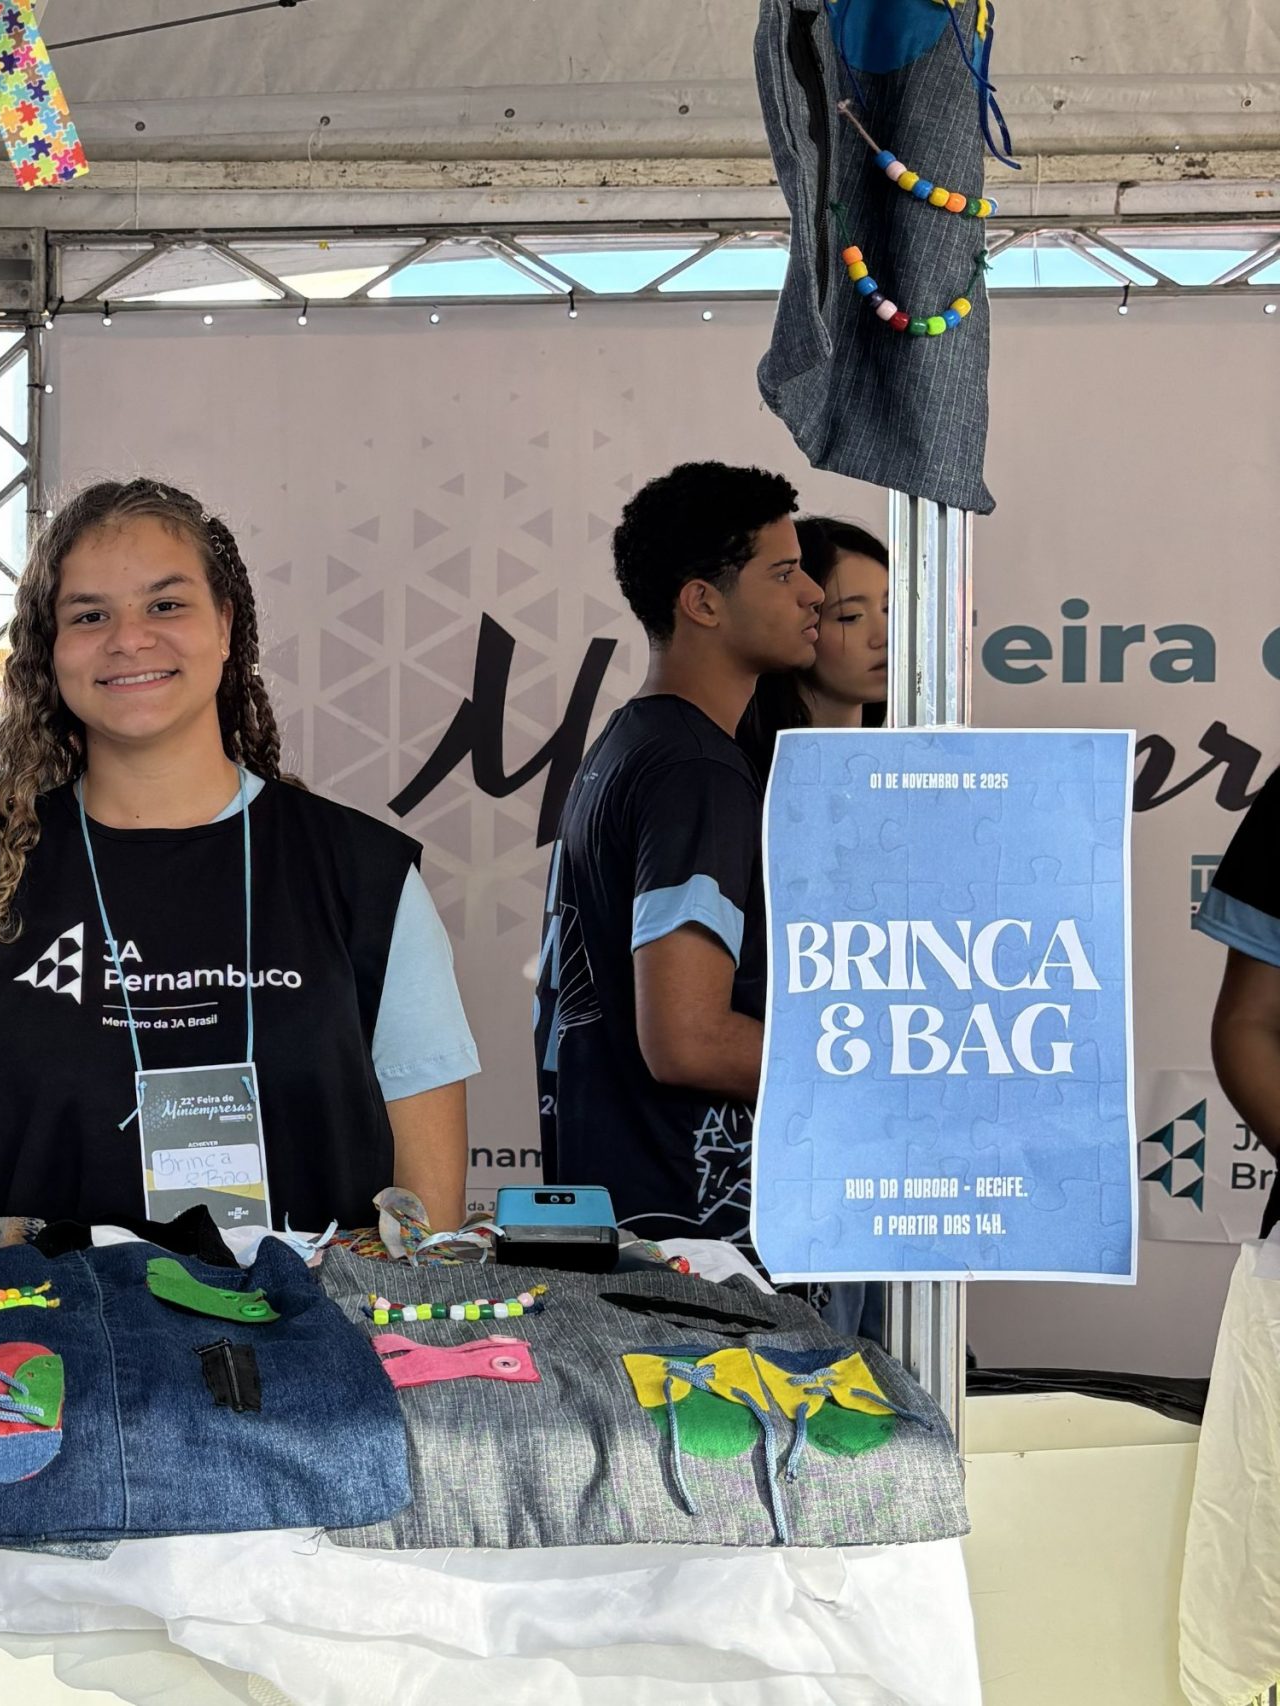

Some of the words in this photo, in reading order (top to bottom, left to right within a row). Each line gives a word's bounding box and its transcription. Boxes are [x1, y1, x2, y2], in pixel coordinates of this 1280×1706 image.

[972, 598, 1216, 685] eira
[869, 773, 882, 789] 01
[885, 773, 899, 789] DE
[902, 773, 959, 789] NOVEMBRO
[962, 773, 977, 789] DE
[980, 773, 1009, 789] 2025
[102, 940, 143, 963] JA
[785, 918, 1102, 995] BRINCA
[104, 964, 302, 993] Pernambuco
[153, 1019, 169, 1029] da
[170, 1018, 186, 1029] JA
[187, 1014, 218, 1027] Brasil
[816, 1002, 872, 1076] &
[889, 1002, 1074, 1076] BAG
[197, 1095, 221, 1104] Feira
[161, 1100, 253, 1121] Miniempresas
[845, 1178, 874, 1199] RUA
[879, 1178, 898, 1199] DA
[904, 1178, 959, 1199] AURORA
[873, 1215, 883, 1235] A
[888, 1215, 938, 1235] PARTIR
[943, 1214, 971, 1235] DAS
[975, 1214, 1007, 1235] 14H.
